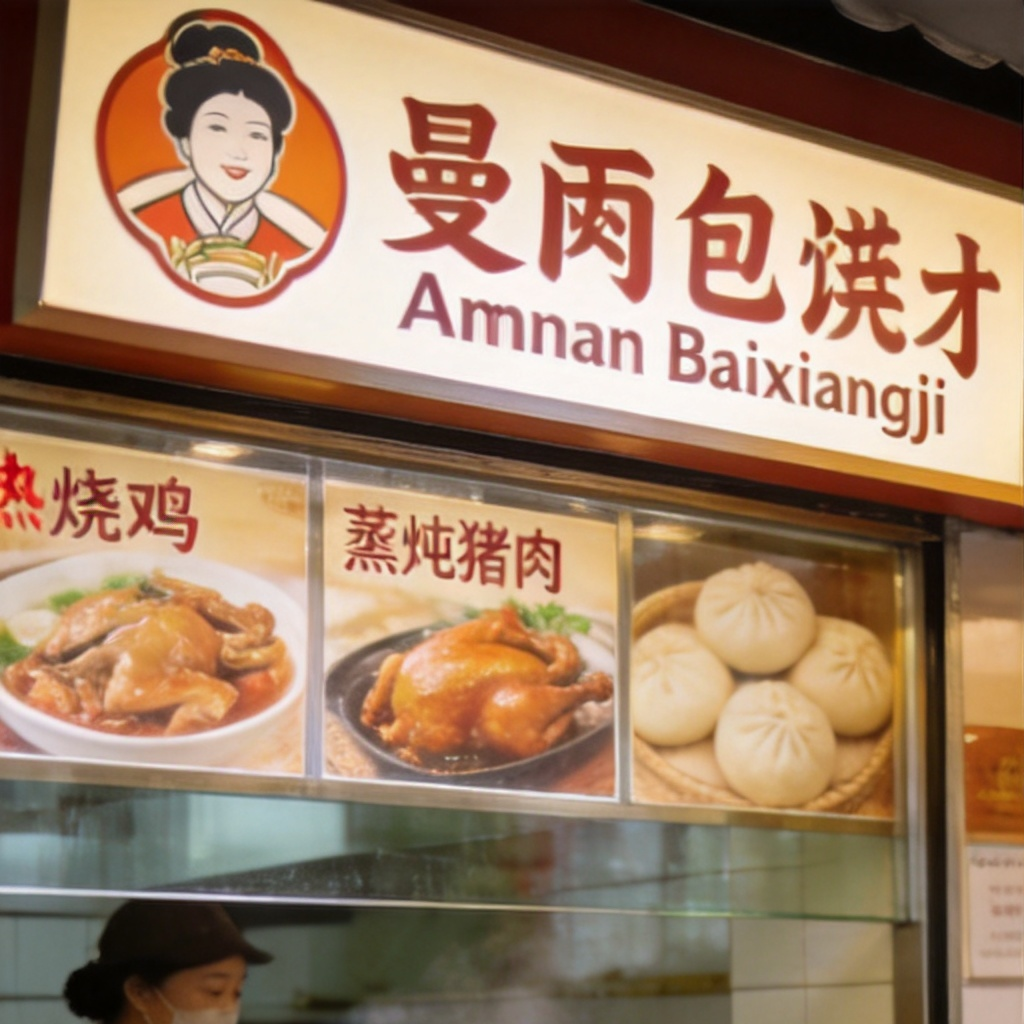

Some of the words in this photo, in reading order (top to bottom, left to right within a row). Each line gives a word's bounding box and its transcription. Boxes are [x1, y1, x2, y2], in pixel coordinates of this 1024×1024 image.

[398, 271, 645, 376] Amnan
[667, 321, 947, 445] Baixiangji
[343, 503, 562, 595] 蒸炖猪肉
